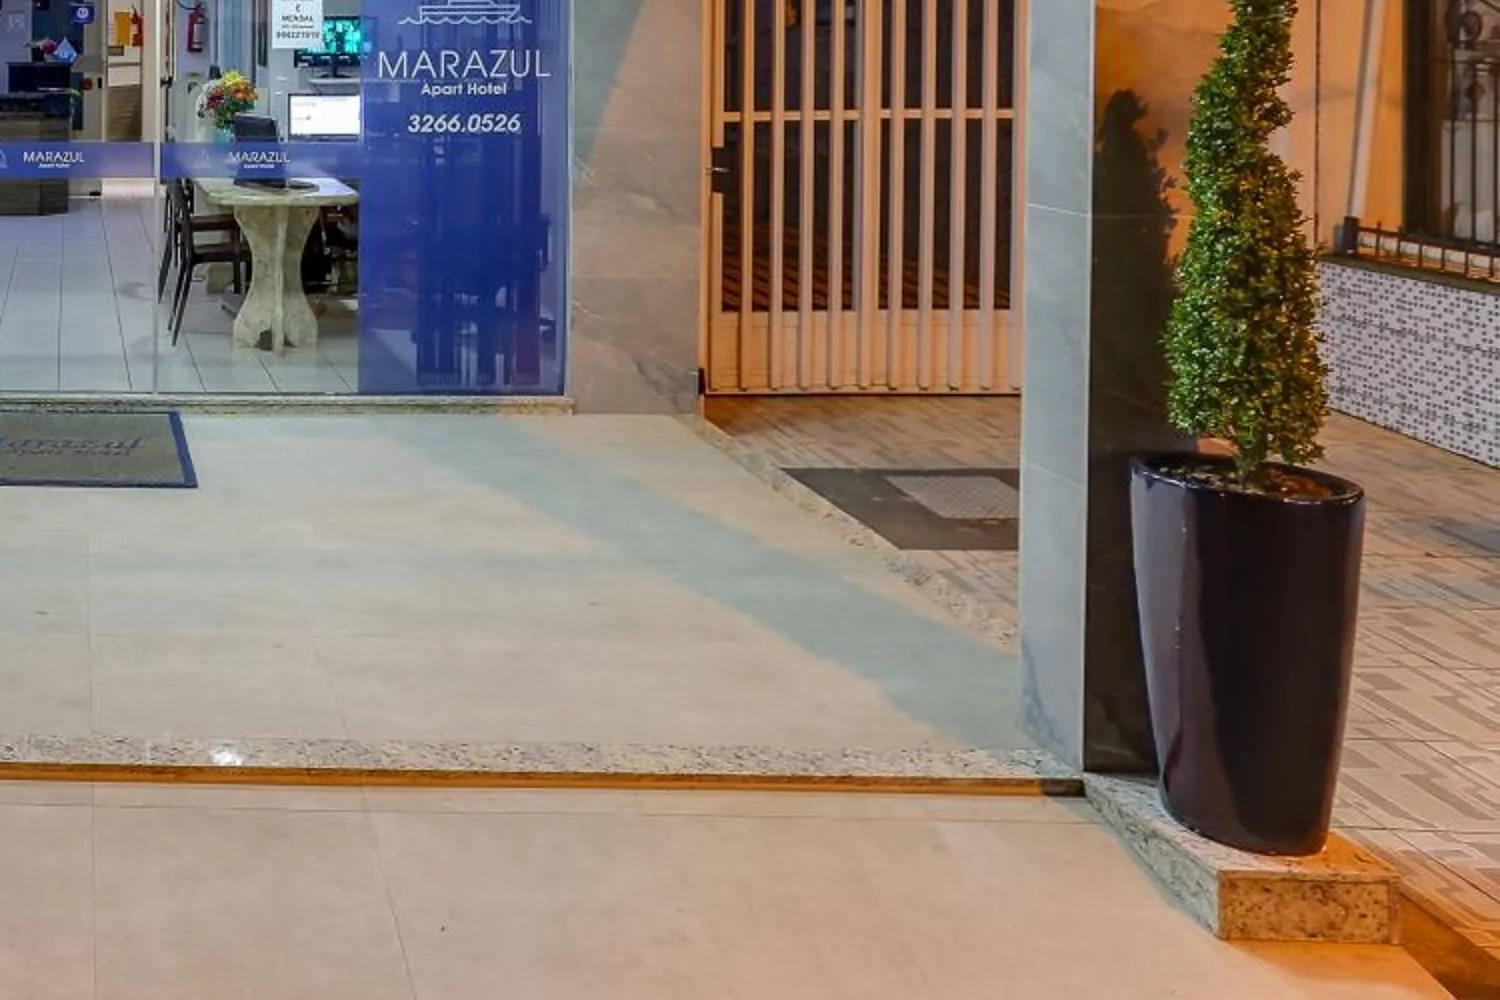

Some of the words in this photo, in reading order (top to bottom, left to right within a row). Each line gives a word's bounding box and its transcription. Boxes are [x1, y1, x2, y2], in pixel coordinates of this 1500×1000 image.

[377, 49, 551, 79] MARAZUL
[421, 82, 463, 97] Apart
[467, 82, 507, 95] Hotel
[408, 113, 521, 133] 3266.0526
[23, 151, 84, 162] MARAZUL
